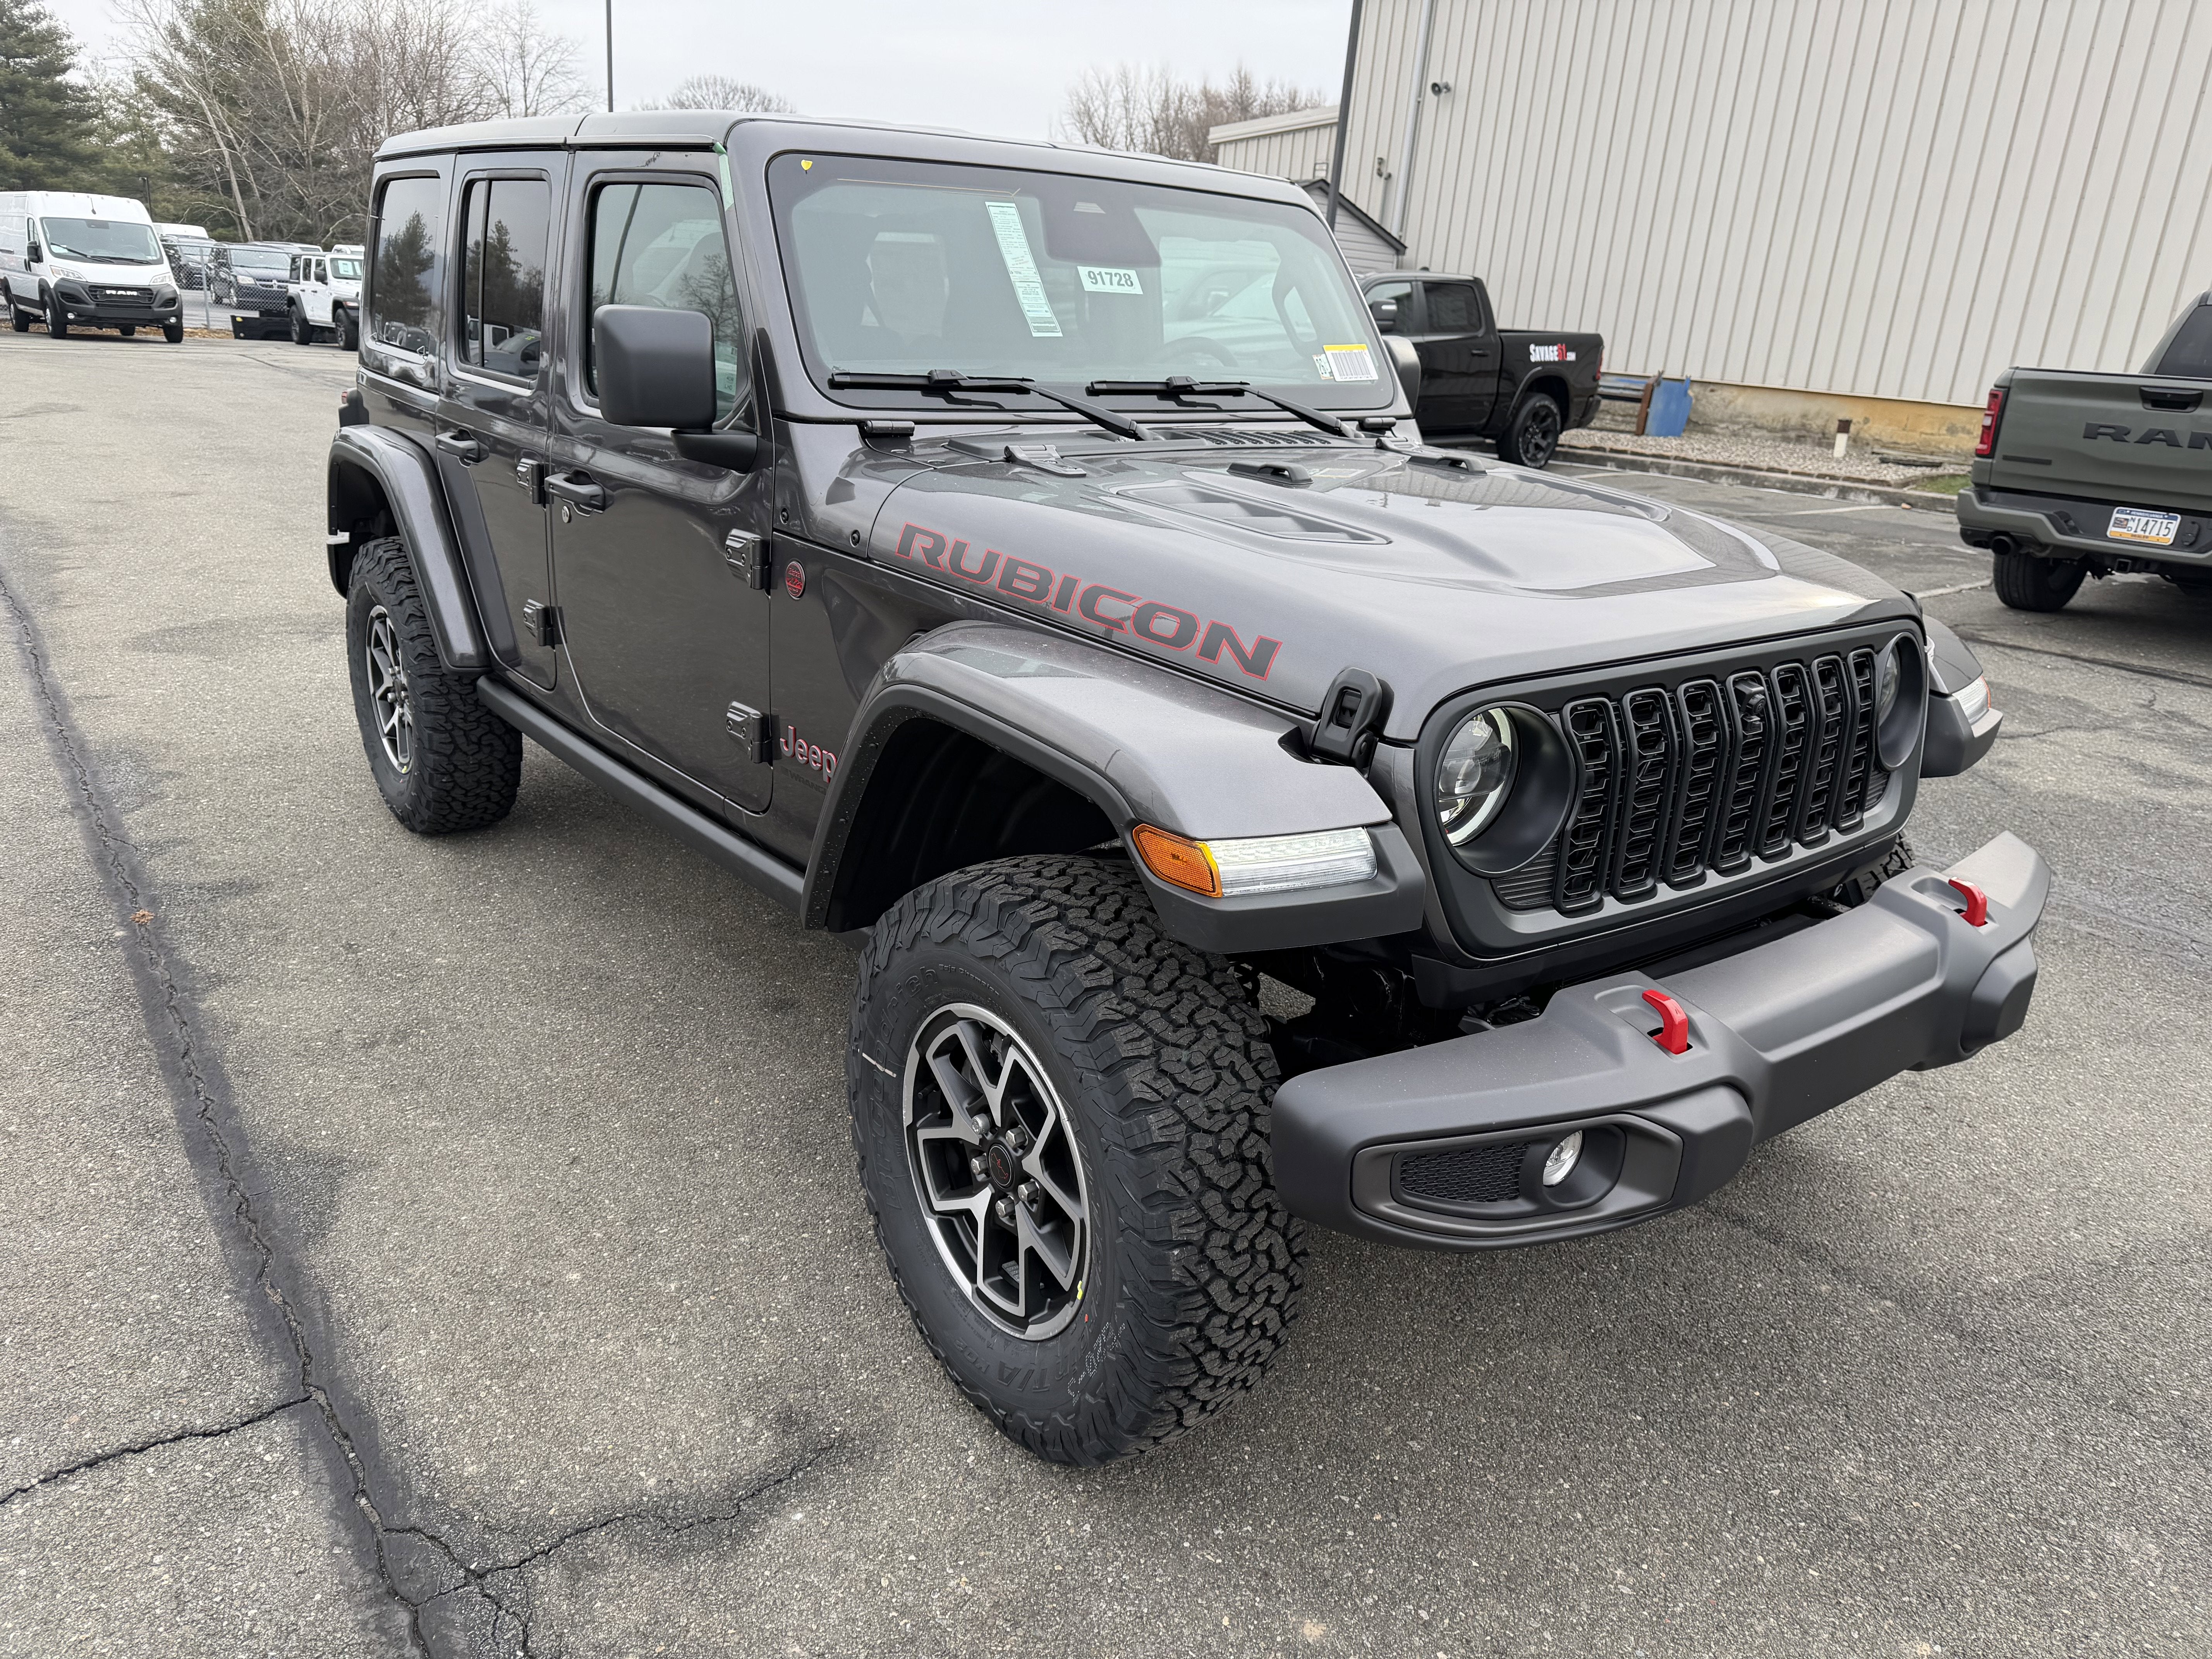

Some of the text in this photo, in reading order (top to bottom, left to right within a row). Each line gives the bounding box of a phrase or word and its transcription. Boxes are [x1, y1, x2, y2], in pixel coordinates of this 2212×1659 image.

[1087, 270, 1133, 287] 91728
[2134, 518, 2173, 536] 14715
[896, 522, 1283, 681] RUBICON
[780, 725, 837, 783] Jeep
